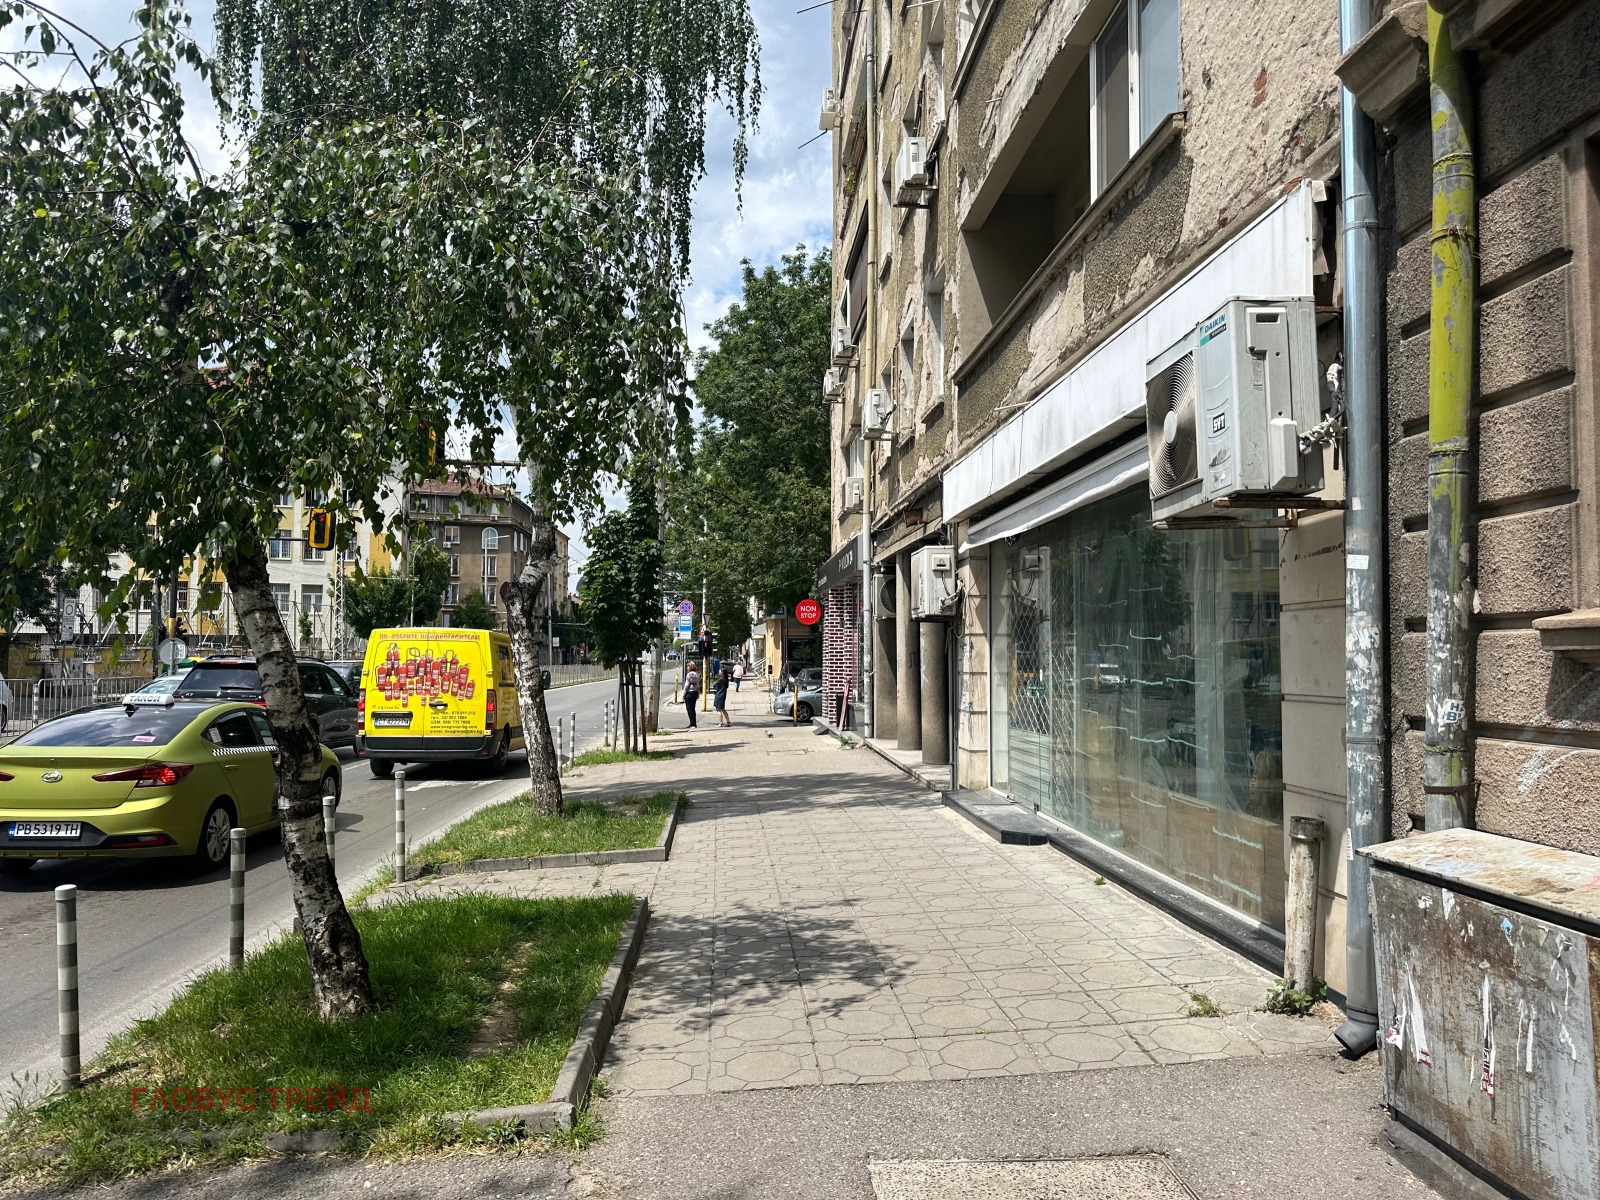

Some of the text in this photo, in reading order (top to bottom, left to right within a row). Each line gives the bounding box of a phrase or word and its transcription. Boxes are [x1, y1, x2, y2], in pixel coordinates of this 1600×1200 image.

[1205, 314, 1225, 333] DAIKIN
[16, 823, 78, 834] PB 5319 TH
